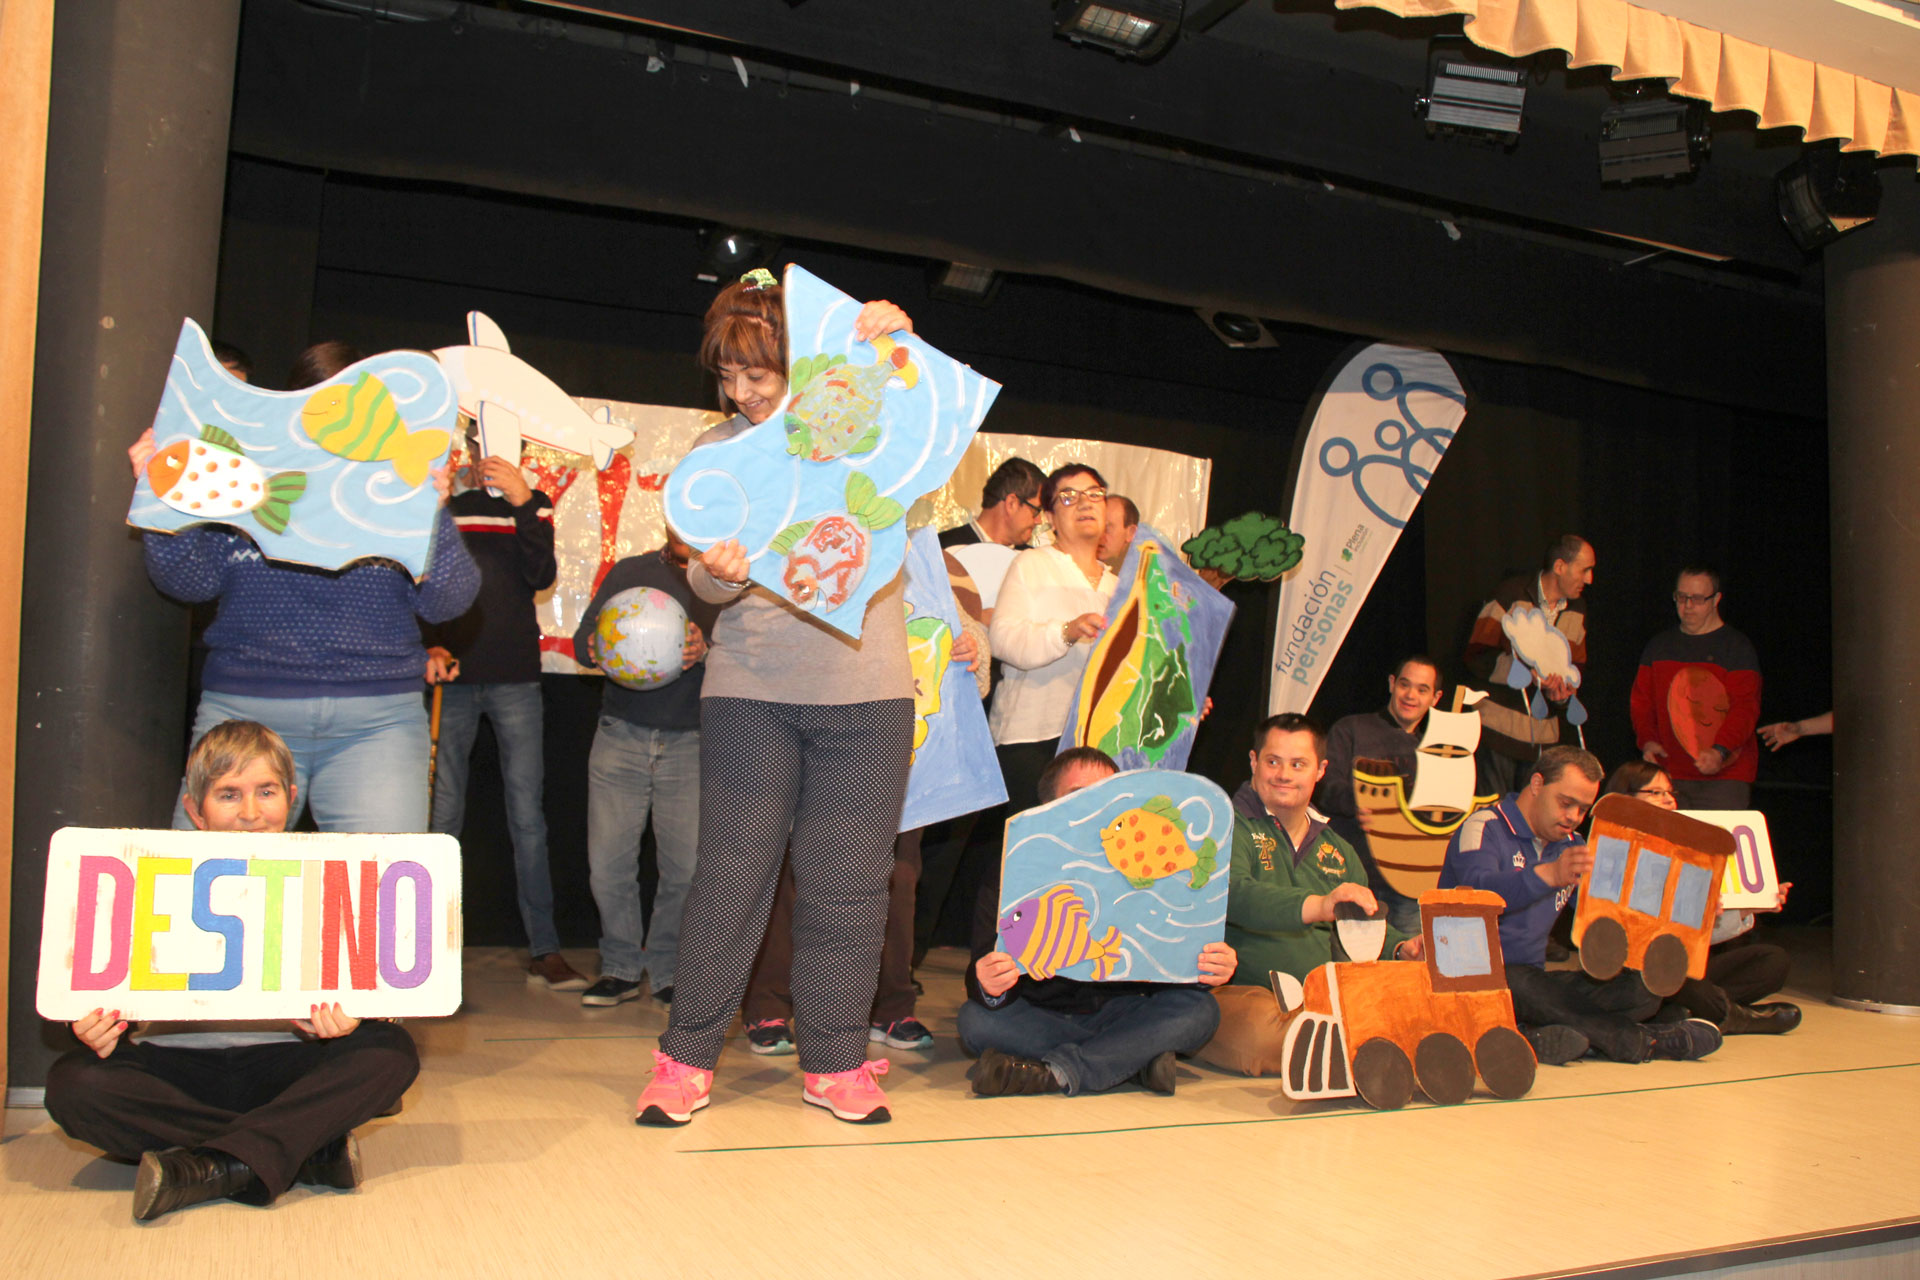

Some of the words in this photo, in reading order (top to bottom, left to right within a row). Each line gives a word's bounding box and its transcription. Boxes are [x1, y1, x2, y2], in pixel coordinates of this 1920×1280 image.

[1345, 523, 1365, 550] Plena
[1275, 570, 1337, 674] fundación
[1291, 580, 1354, 686] personas
[70, 855, 433, 991] DESTINO
